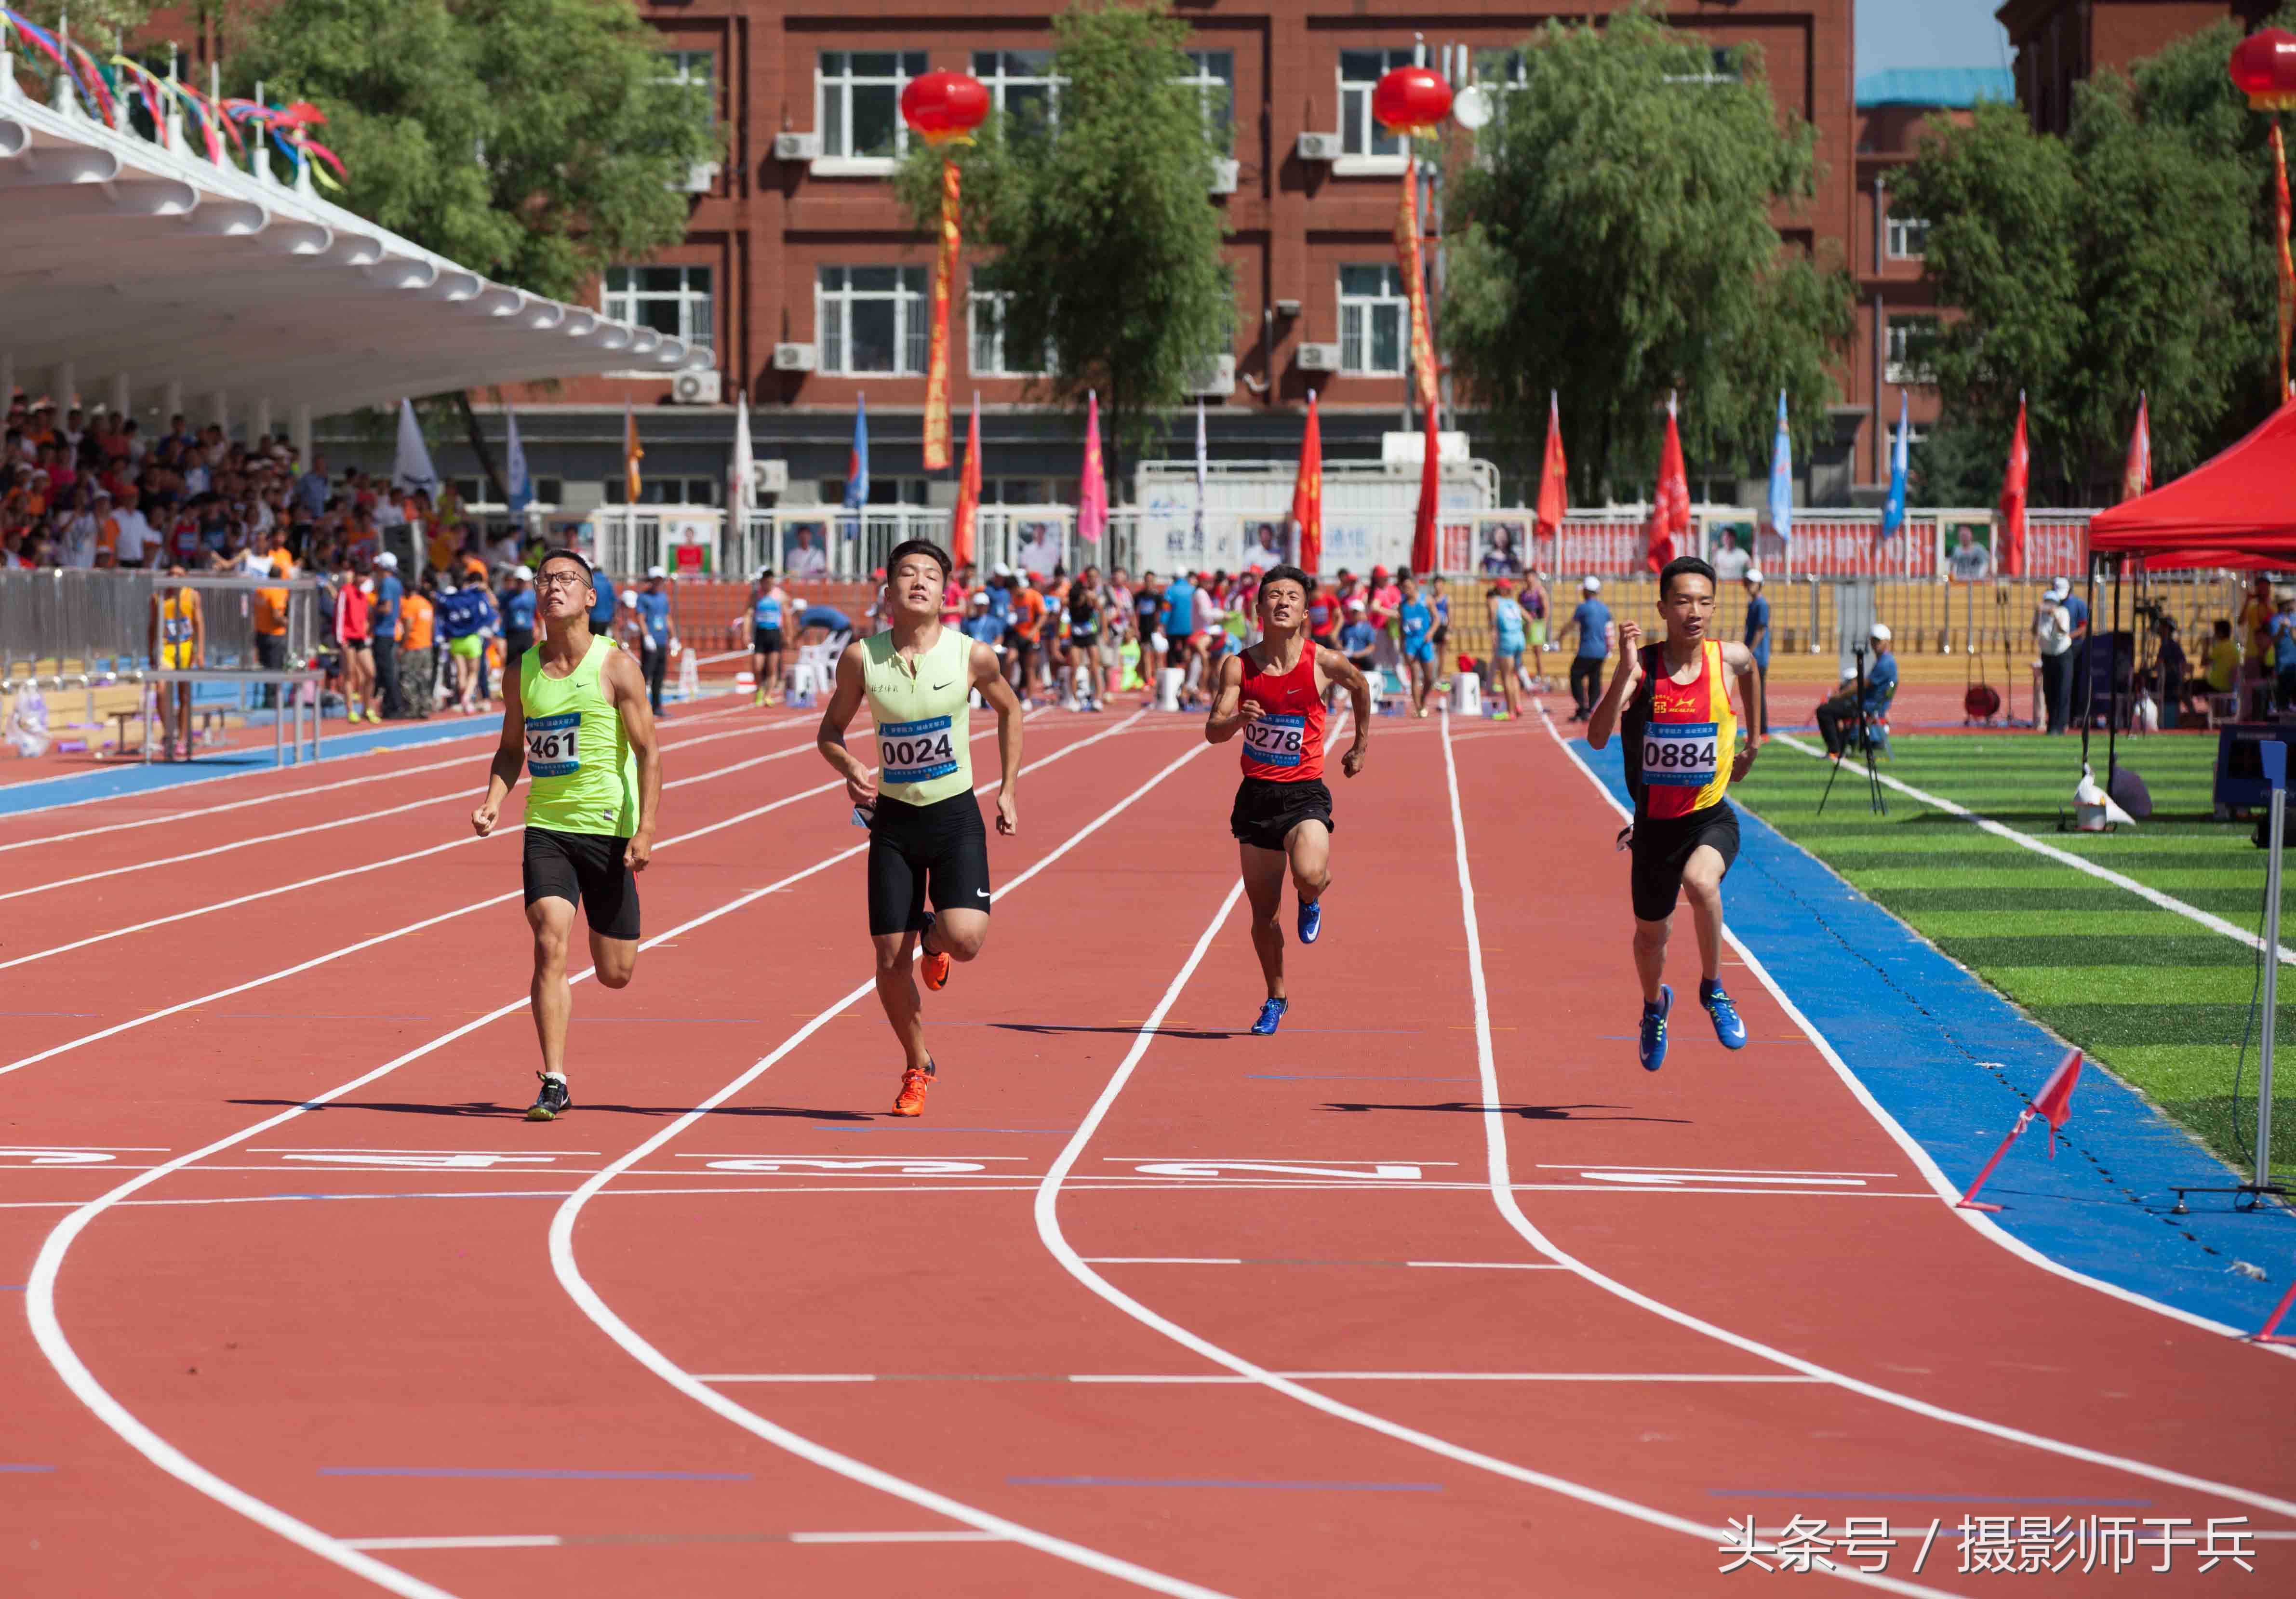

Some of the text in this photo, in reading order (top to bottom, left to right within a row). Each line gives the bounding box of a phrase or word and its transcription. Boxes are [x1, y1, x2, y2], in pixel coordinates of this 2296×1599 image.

[882, 734, 953, 765] 0024
[1246, 723, 1301, 751] 0278
[1645, 742, 1716, 767] 0884
